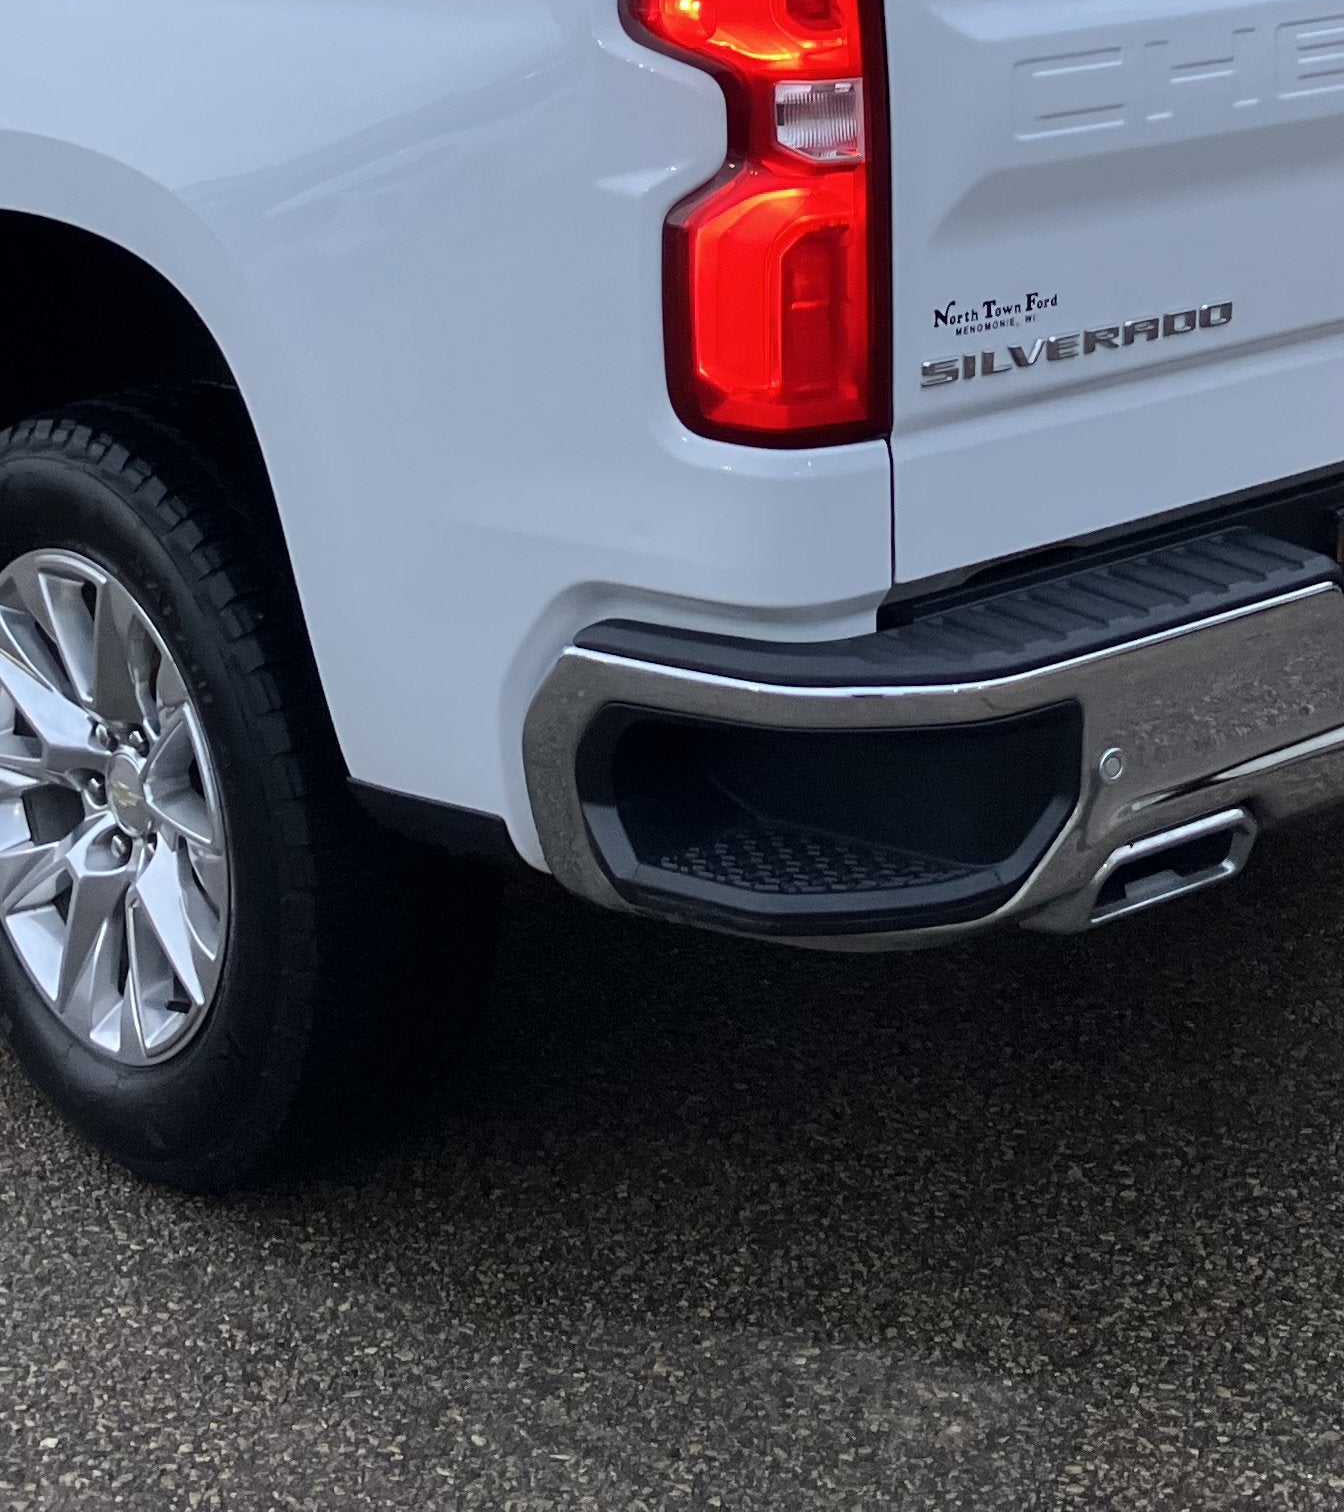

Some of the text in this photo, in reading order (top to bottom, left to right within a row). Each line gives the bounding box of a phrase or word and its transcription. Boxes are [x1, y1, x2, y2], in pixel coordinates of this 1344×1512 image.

[933, 292, 1058, 329] North Town Ford
[1024, 314, 1037, 324] WI
[920, 300, 1233, 388] SILVERADO
